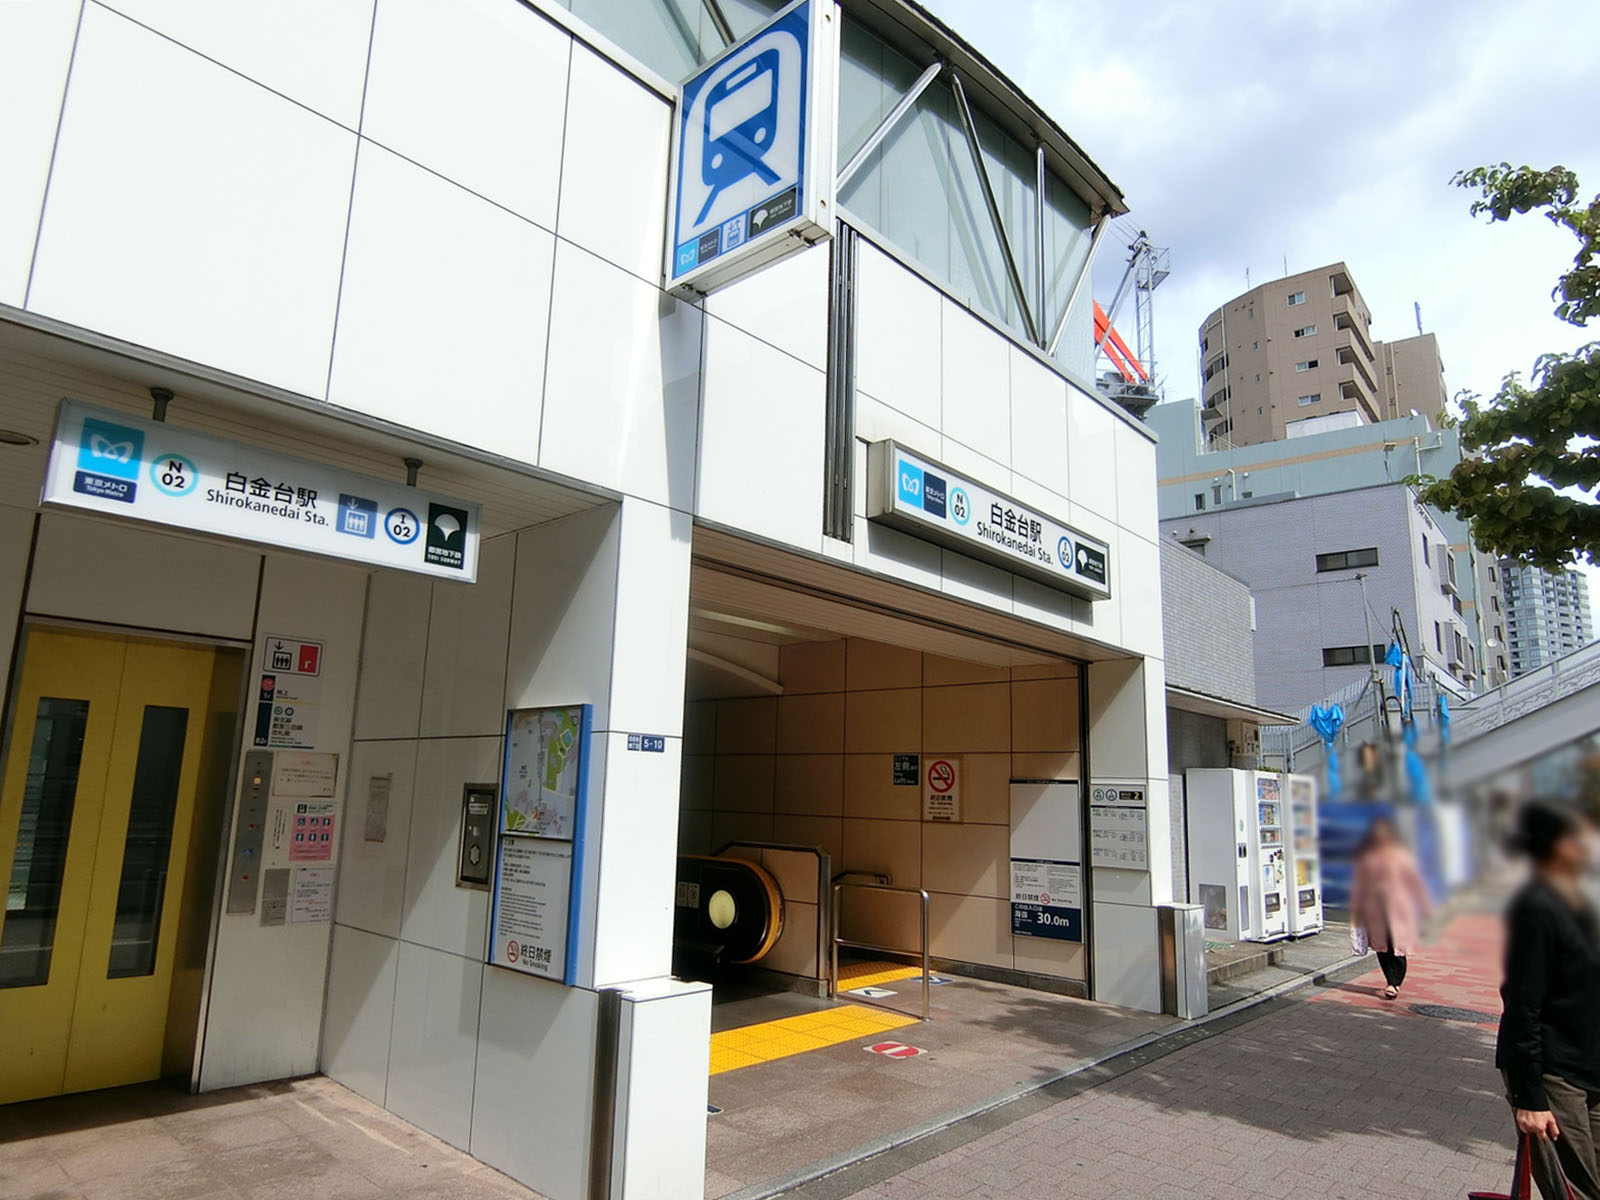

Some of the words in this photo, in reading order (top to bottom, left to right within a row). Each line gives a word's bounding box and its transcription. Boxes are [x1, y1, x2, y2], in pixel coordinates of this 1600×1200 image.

[169, 460, 183, 473] N
[84, 477, 128, 492] 東京メトロ
[162, 473, 185, 488] 02
[225, 471, 318, 509] 白金台駅
[956, 493, 963, 504] N
[207, 489, 300, 520] Shirokanedai
[304, 510, 329, 527] Sta.
[954, 504, 966, 518] 02
[400, 514, 406, 524] I
[991, 502, 1042, 544] 白金台駅
[393, 524, 411, 538] 02
[976, 521, 1036, 558] Shirokanedai
[1037, 547, 1054, 565] Sta.
[1061, 551, 1070, 563] 02
[643, 738, 663, 749] 5-10
[1133, 791, 1140, 800] 2
[1036, 912, 1070, 927] 30.0m
[520, 943, 552, 963] 終日禁煙
